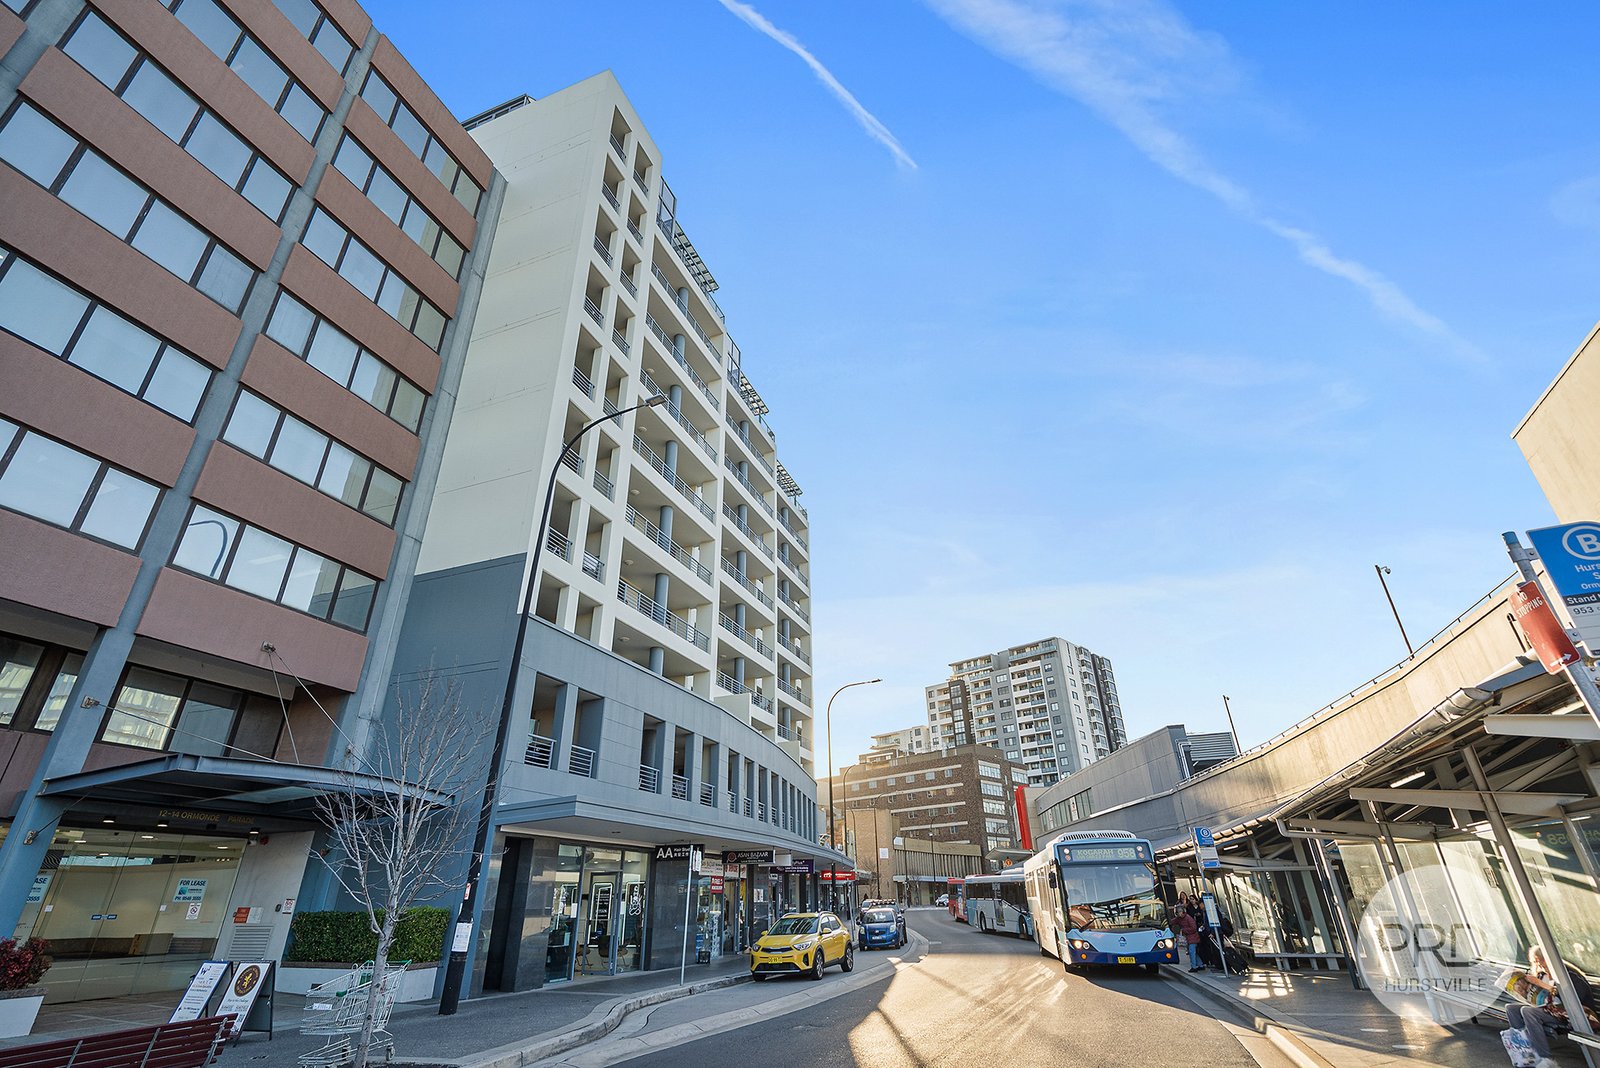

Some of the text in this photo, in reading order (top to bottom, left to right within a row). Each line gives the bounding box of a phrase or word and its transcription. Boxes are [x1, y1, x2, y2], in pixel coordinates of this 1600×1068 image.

[1517, 591, 1528, 604] NO
[1567, 594, 1597, 605] Stand
[1517, 596, 1543, 618] STOPPING
[1573, 606, 1594, 615] 953
[159, 809, 180, 818] 12-14
[181, 811, 220, 821] ORMONDE
[656, 847, 673, 859] AA
[750, 851, 769, 859] BAZAAR
[1077, 848, 1114, 857] KOGARAH
[1117, 847, 1136, 859] 958
